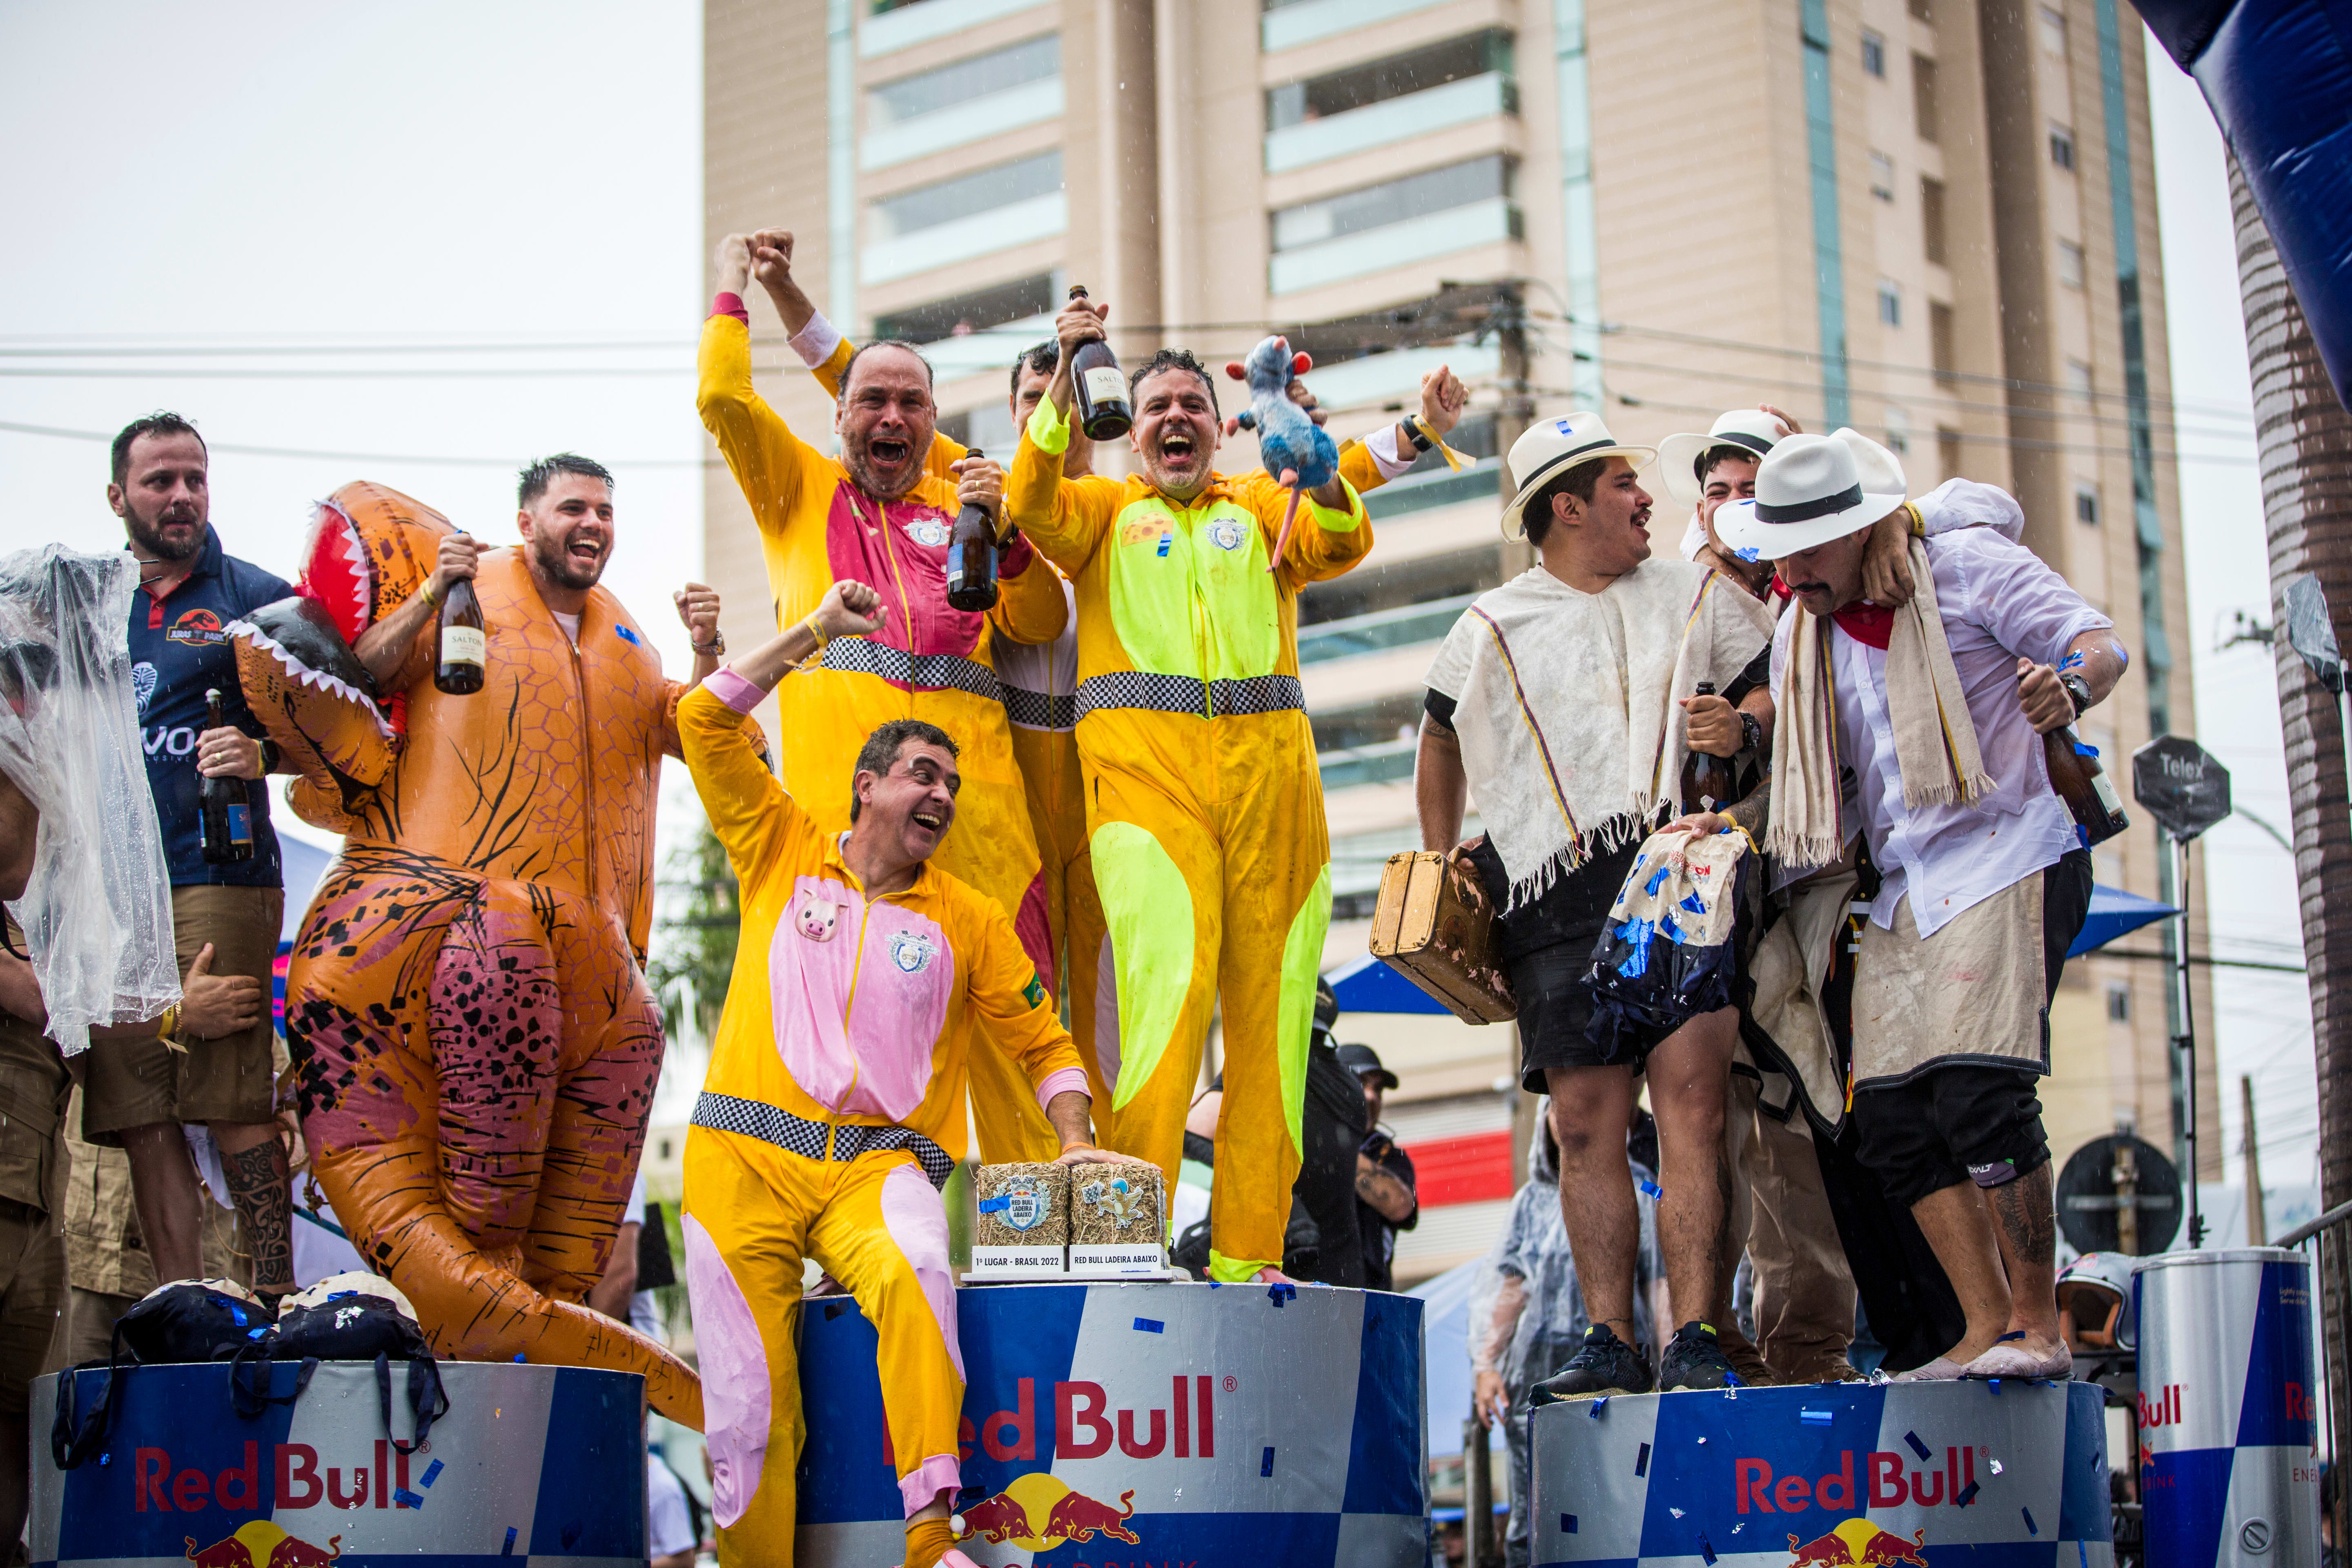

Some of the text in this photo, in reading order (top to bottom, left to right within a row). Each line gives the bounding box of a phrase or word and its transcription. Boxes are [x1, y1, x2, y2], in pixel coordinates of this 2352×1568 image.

[205, 632, 225, 642] PARK
[452, 636, 482, 646] SALTON
[2159, 753, 2204, 780] Telex
[1055, 1376, 1214, 1459] Bull
[2138, 1384, 2181, 1429] Bull
[2285, 1382, 2316, 1421] Re
[136, 1439, 410, 1512] Red Bull
[1735, 1446, 1976, 1514] Red Bull
